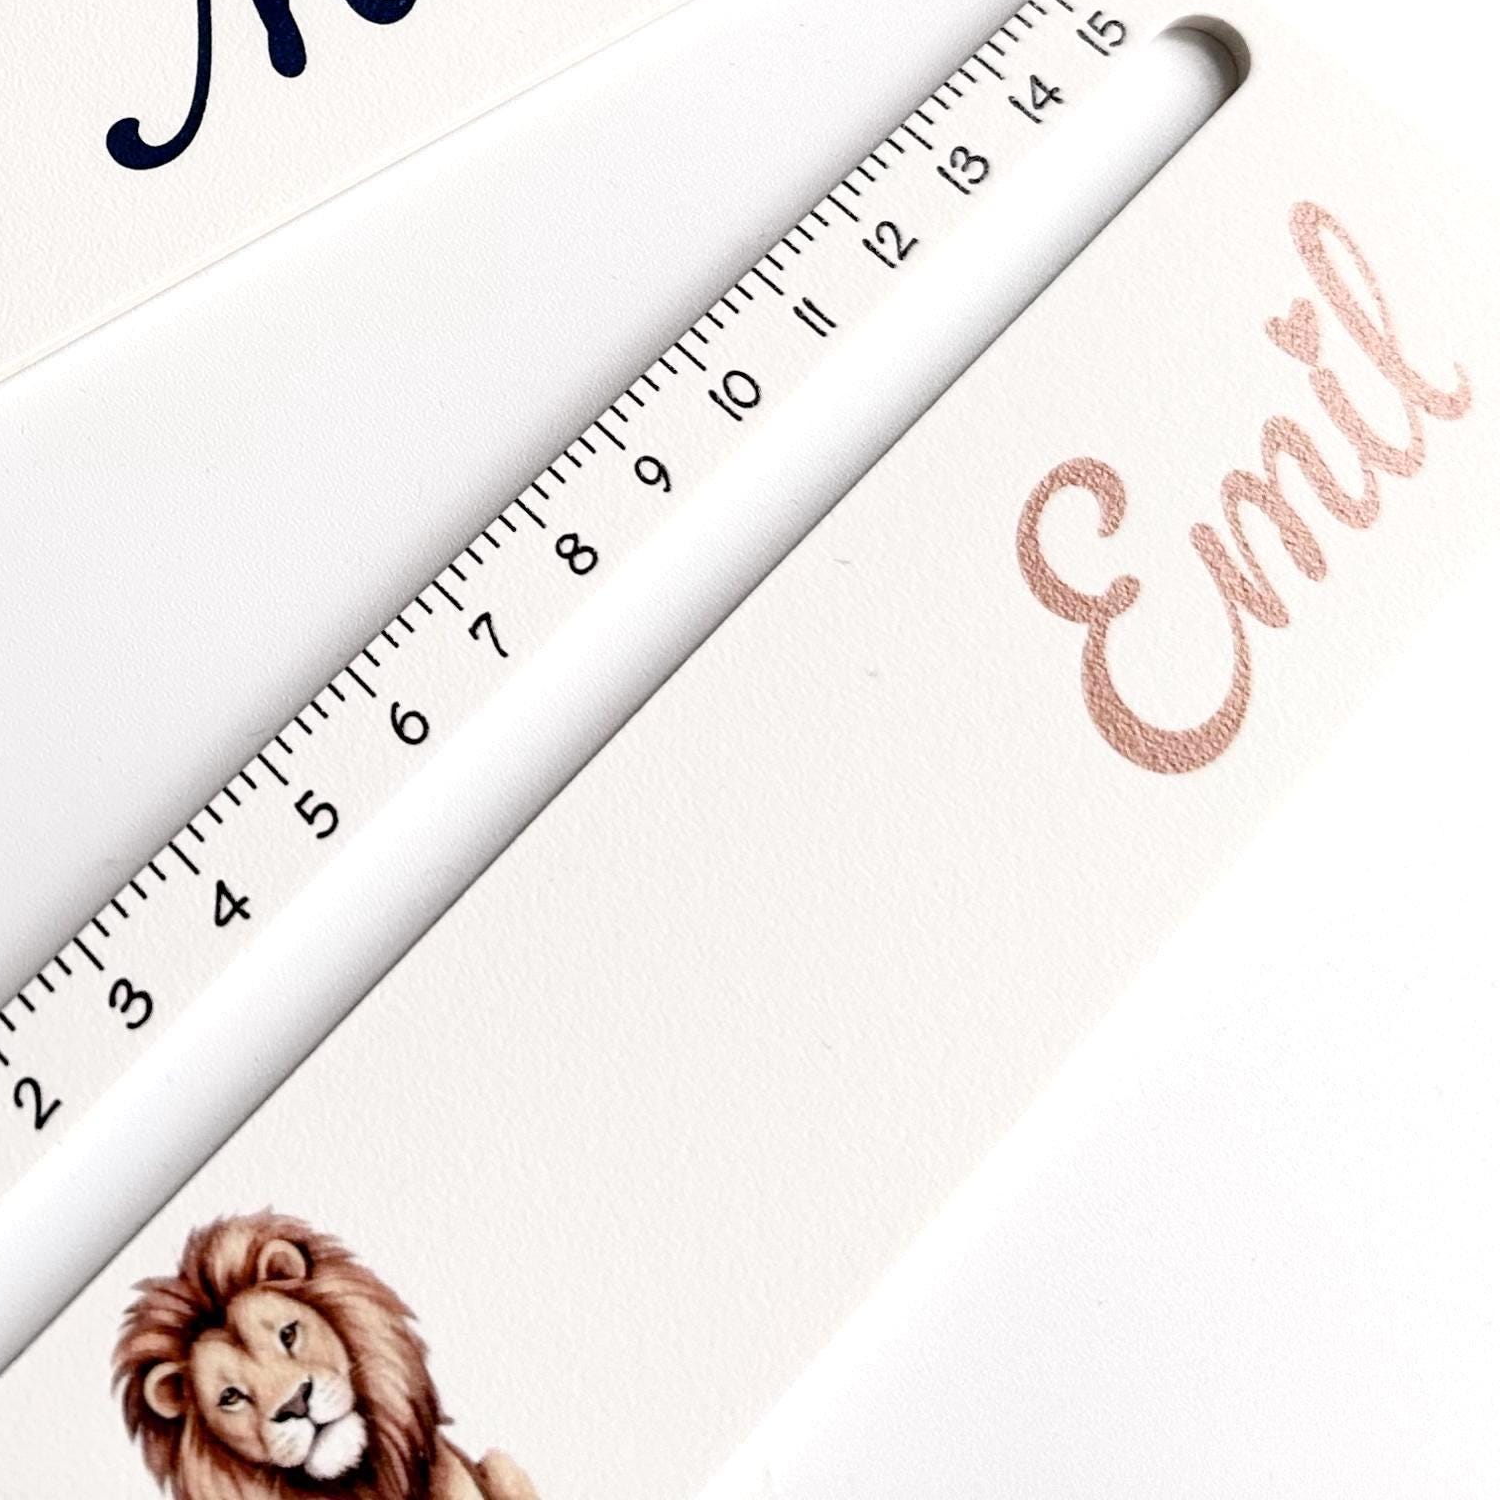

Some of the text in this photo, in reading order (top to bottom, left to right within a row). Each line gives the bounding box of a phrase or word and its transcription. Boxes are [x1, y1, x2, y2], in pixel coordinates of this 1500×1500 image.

[13, 1077, 62, 1130] 2
[108, 978, 154, 1030] 3
[214, 879, 251, 927] 4
[294, 790, 339, 840] 5
[390, 701, 430, 745] 6
[468, 611, 509, 658] 7
[555, 533, 599, 576] 8
[634, 455, 672, 493] 9
[708, 370, 761, 422] 10
[793, 297, 837, 337] 11
[862, 221, 919, 269] 12
[937, 146, 990, 195] 13
[1008, 75, 1064, 124] 14
[1076, 11, 1126, 56] 15
[1016, 200, 1473, 774] Emil
